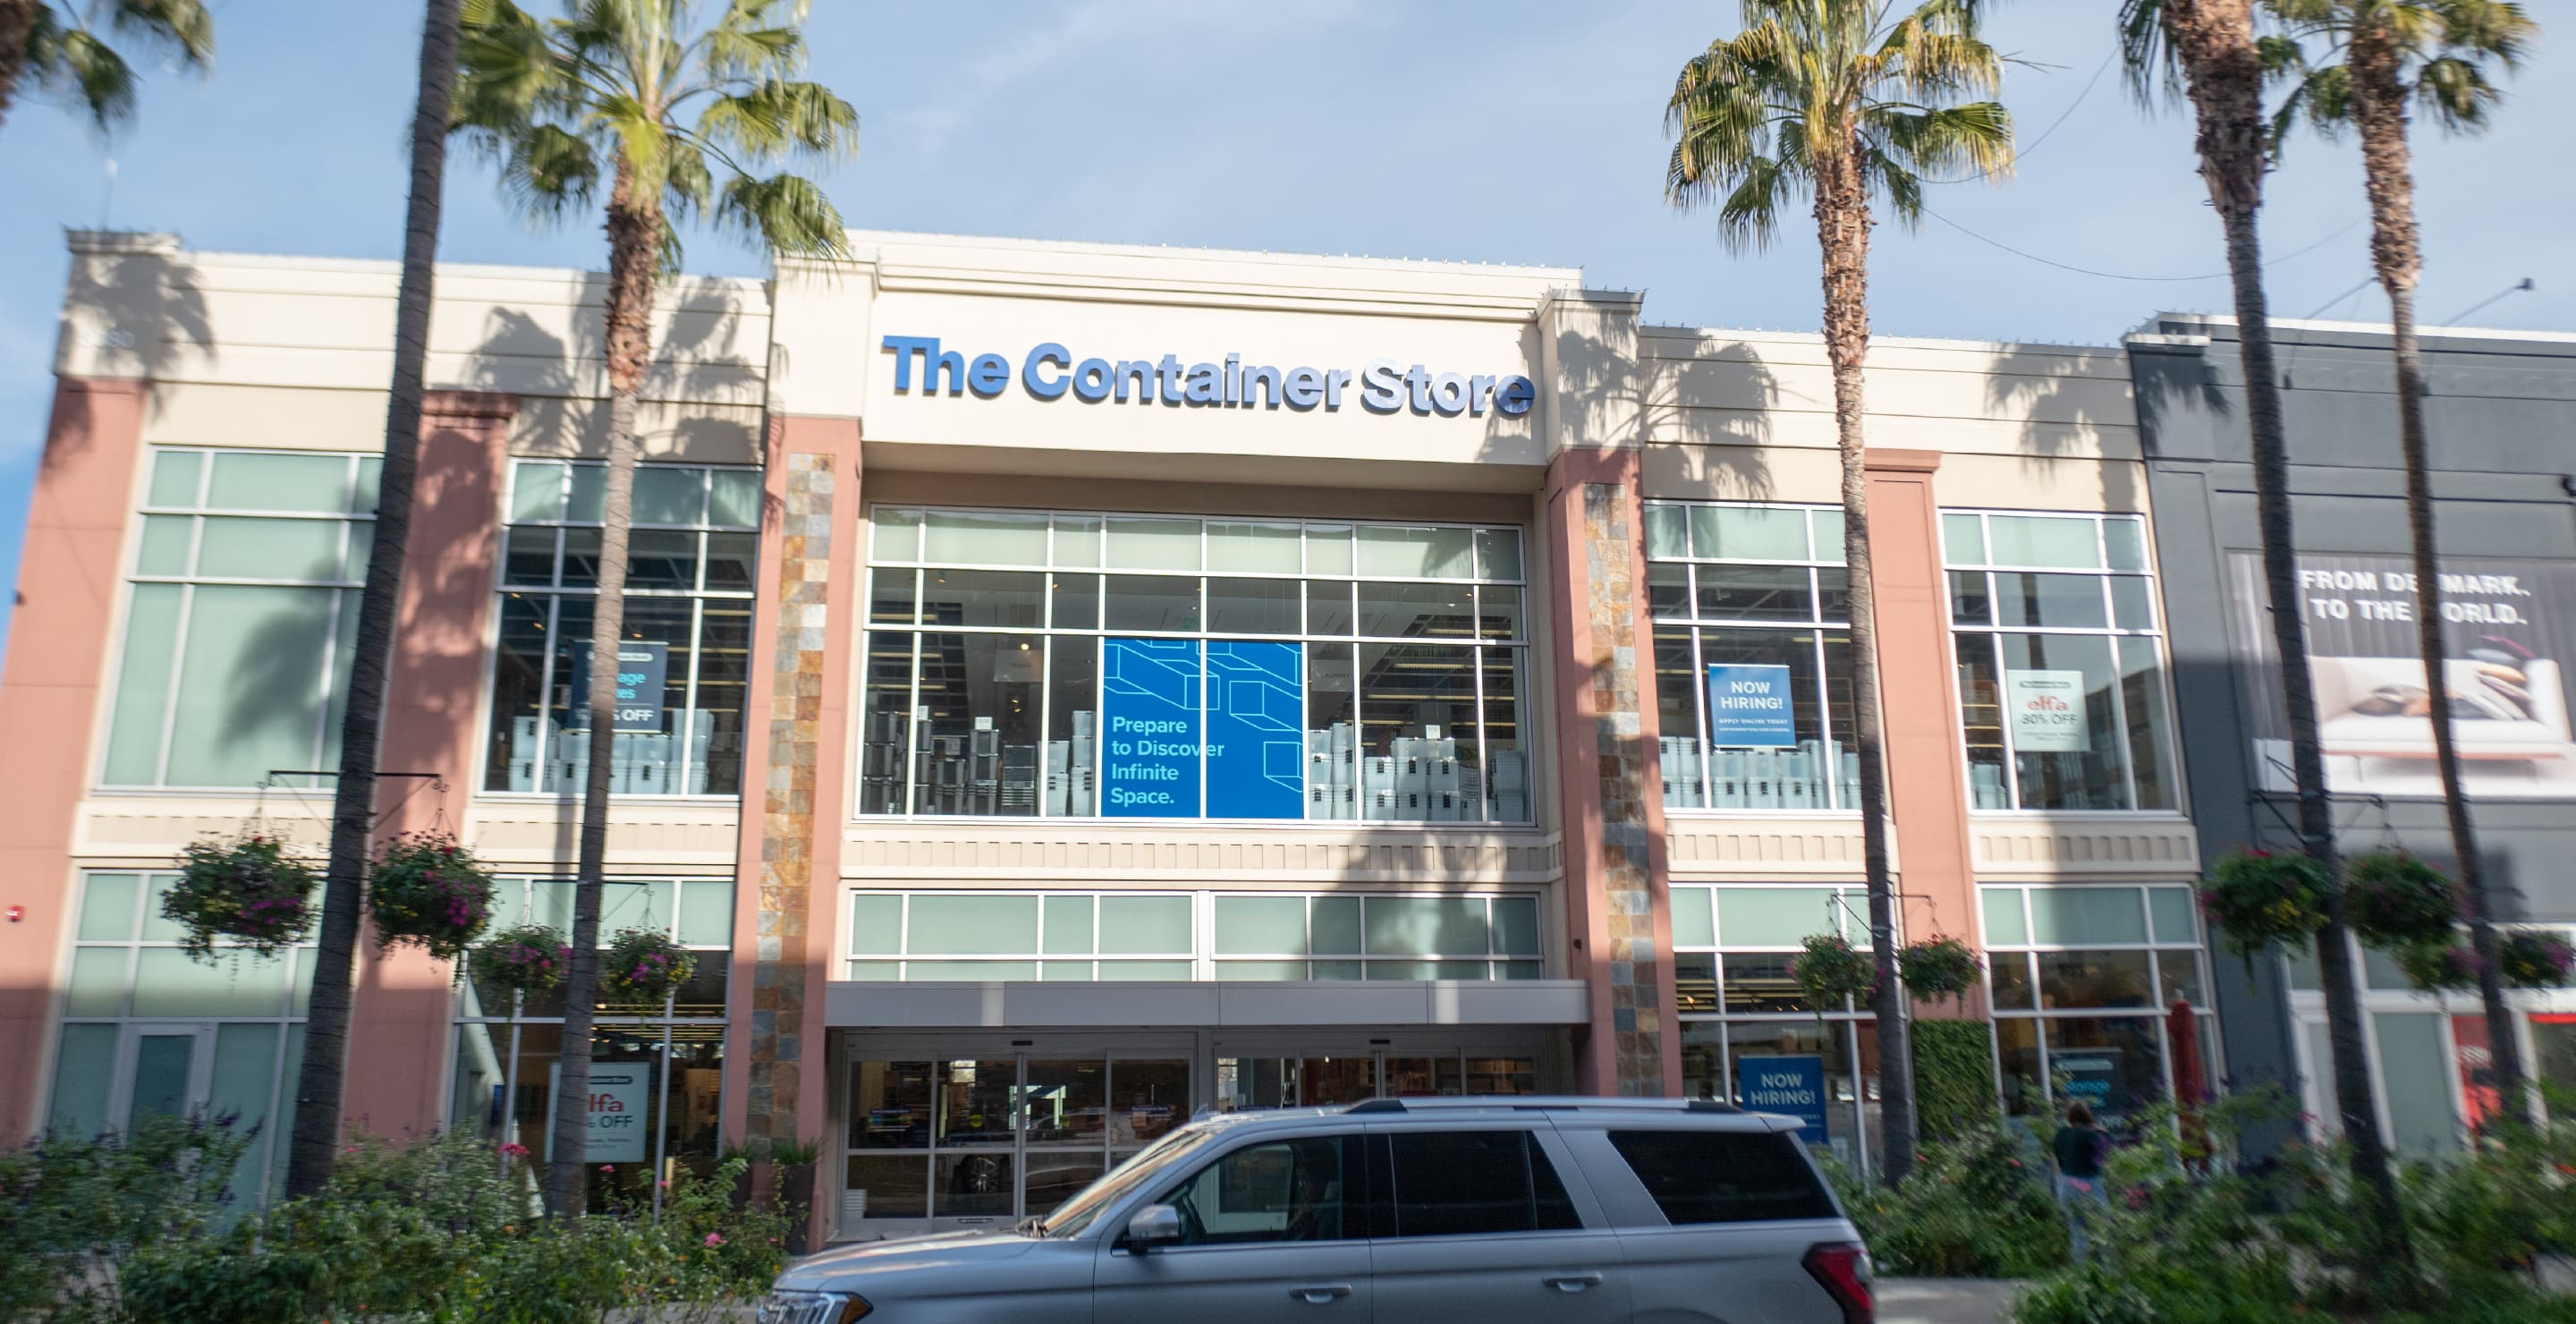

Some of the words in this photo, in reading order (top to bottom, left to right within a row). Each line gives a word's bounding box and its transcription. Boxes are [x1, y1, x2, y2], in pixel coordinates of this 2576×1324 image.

[883, 335, 1010, 397] The
[1022, 342, 1352, 413] Container
[1360, 357, 1536, 420] Store
[2298, 570, 2378, 591] FROM
[2385, 572, 2530, 597] DEMARK.
[2309, 598, 2350, 619] TO
[2355, 599, 2413, 621] THE
[2439, 601, 2529, 624] ORLD.
[1731, 681, 1771, 694] NOW
[1720, 697, 1784, 709] HIRING!
[2027, 695, 2069, 711] elfa
[622, 709, 655, 721] OFF
[2021, 714, 2048, 725] 30%
[2052, 714, 2079, 725] OFF
[1113, 717, 1187, 736] Prepare
[1112, 741, 1131, 756] to
[1137, 740, 1224, 757] Discover
[1111, 763, 1179, 781] Infinite
[1111, 787, 1174, 807] Space.
[1760, 1074, 1803, 1088] NOW
[589, 1093, 624, 1112] lfa
[1750, 1090, 1817, 1105] HIRING!
[600, 1116, 633, 1128] OFF
